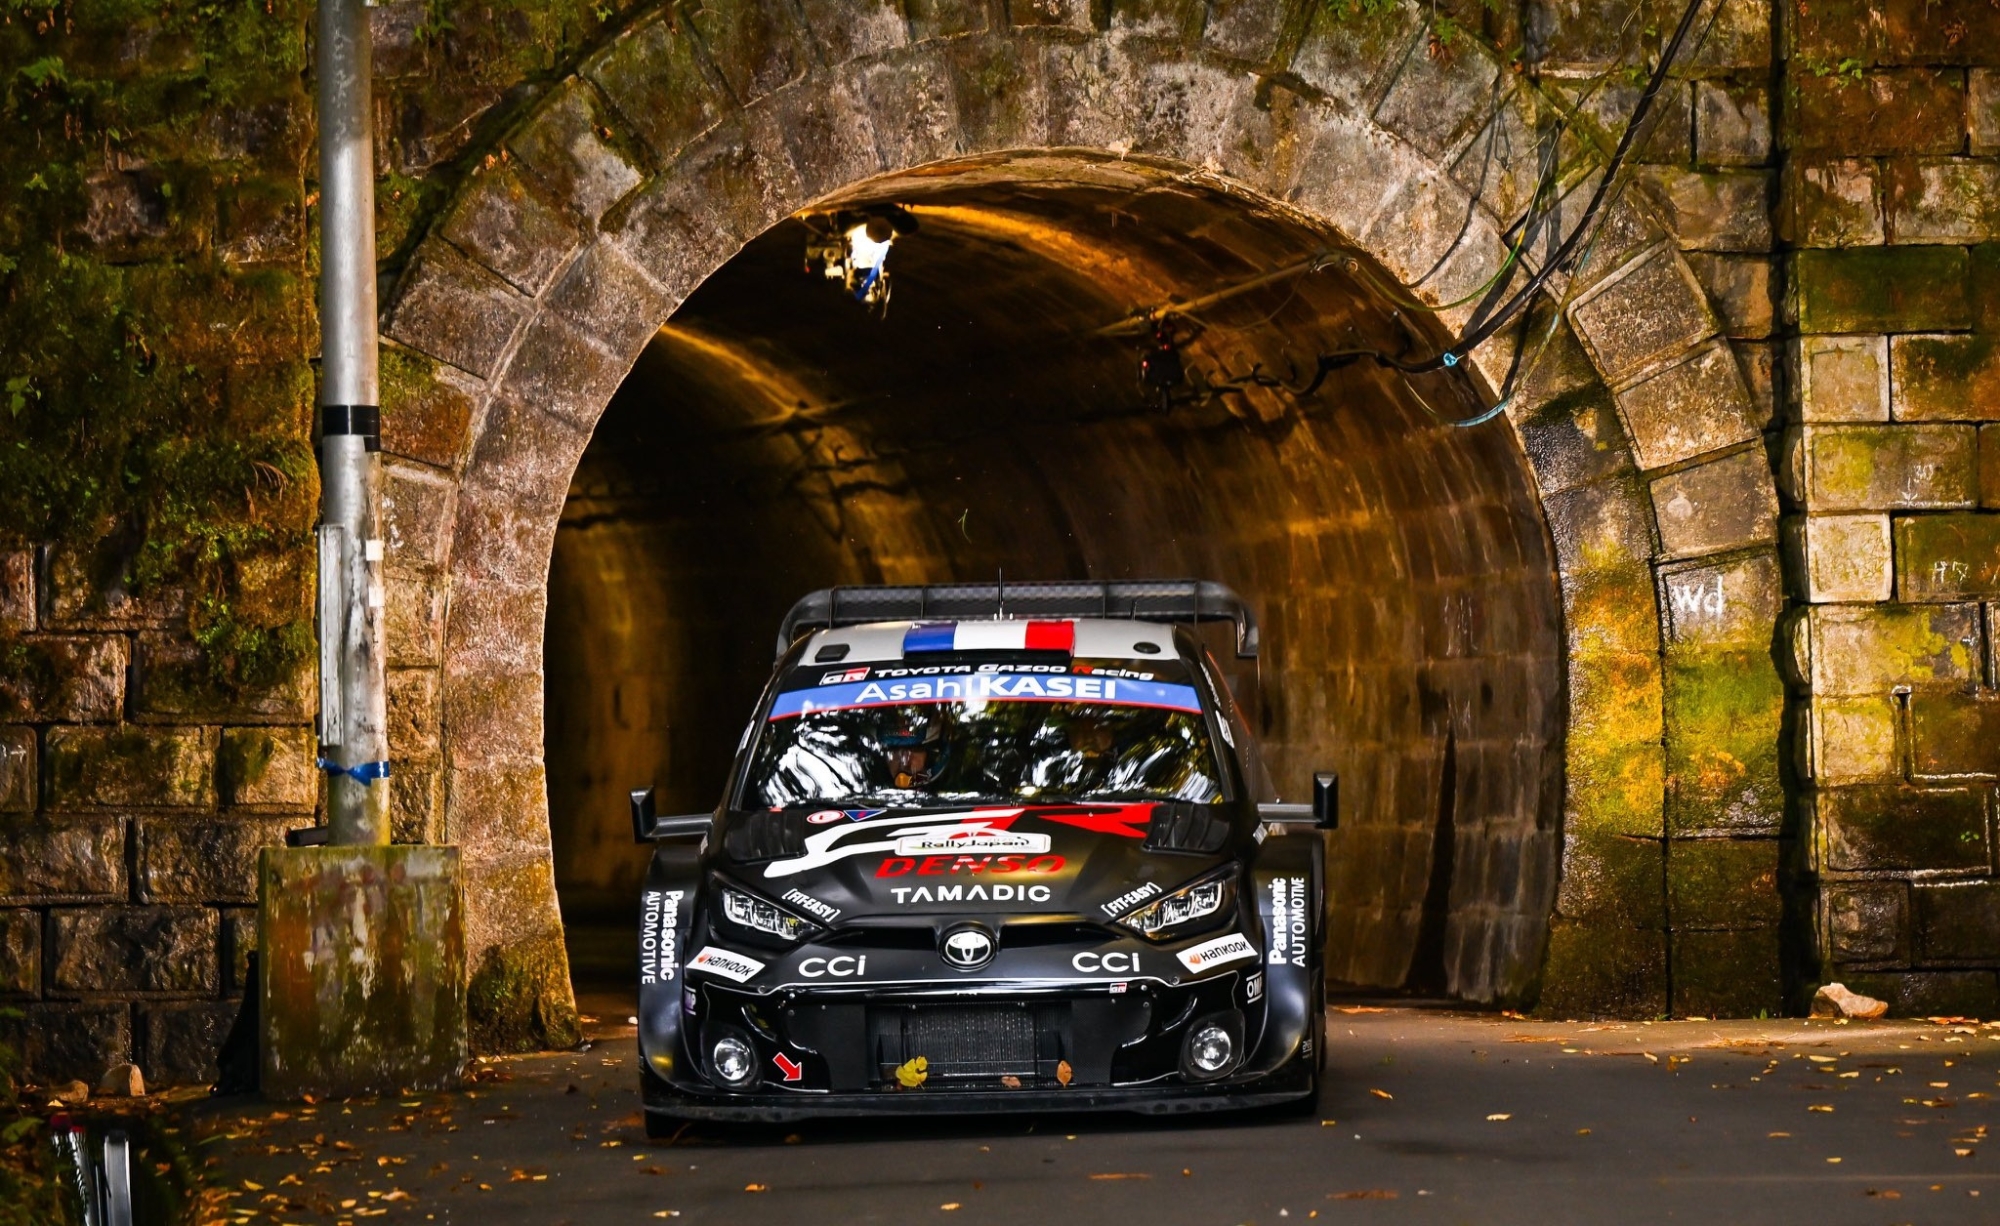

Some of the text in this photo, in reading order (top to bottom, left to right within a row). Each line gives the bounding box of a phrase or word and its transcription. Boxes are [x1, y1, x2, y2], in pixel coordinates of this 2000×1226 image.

[855, 676, 1116, 703] Asahi KASEI
[875, 665, 971, 677] TOYOTA
[978, 664, 1067, 673] GAZOO
[1072, 665, 1154, 680] Racing
[874, 855, 1066, 878] DENSO
[891, 885, 1050, 903] TAMADIC
[642, 891, 661, 984] AUTOMOTIVE
[660, 890, 684, 981] Panasonic
[1267, 877, 1287, 965] Panasonic
[1291, 877, 1305, 967] AUTOMOTIVE
